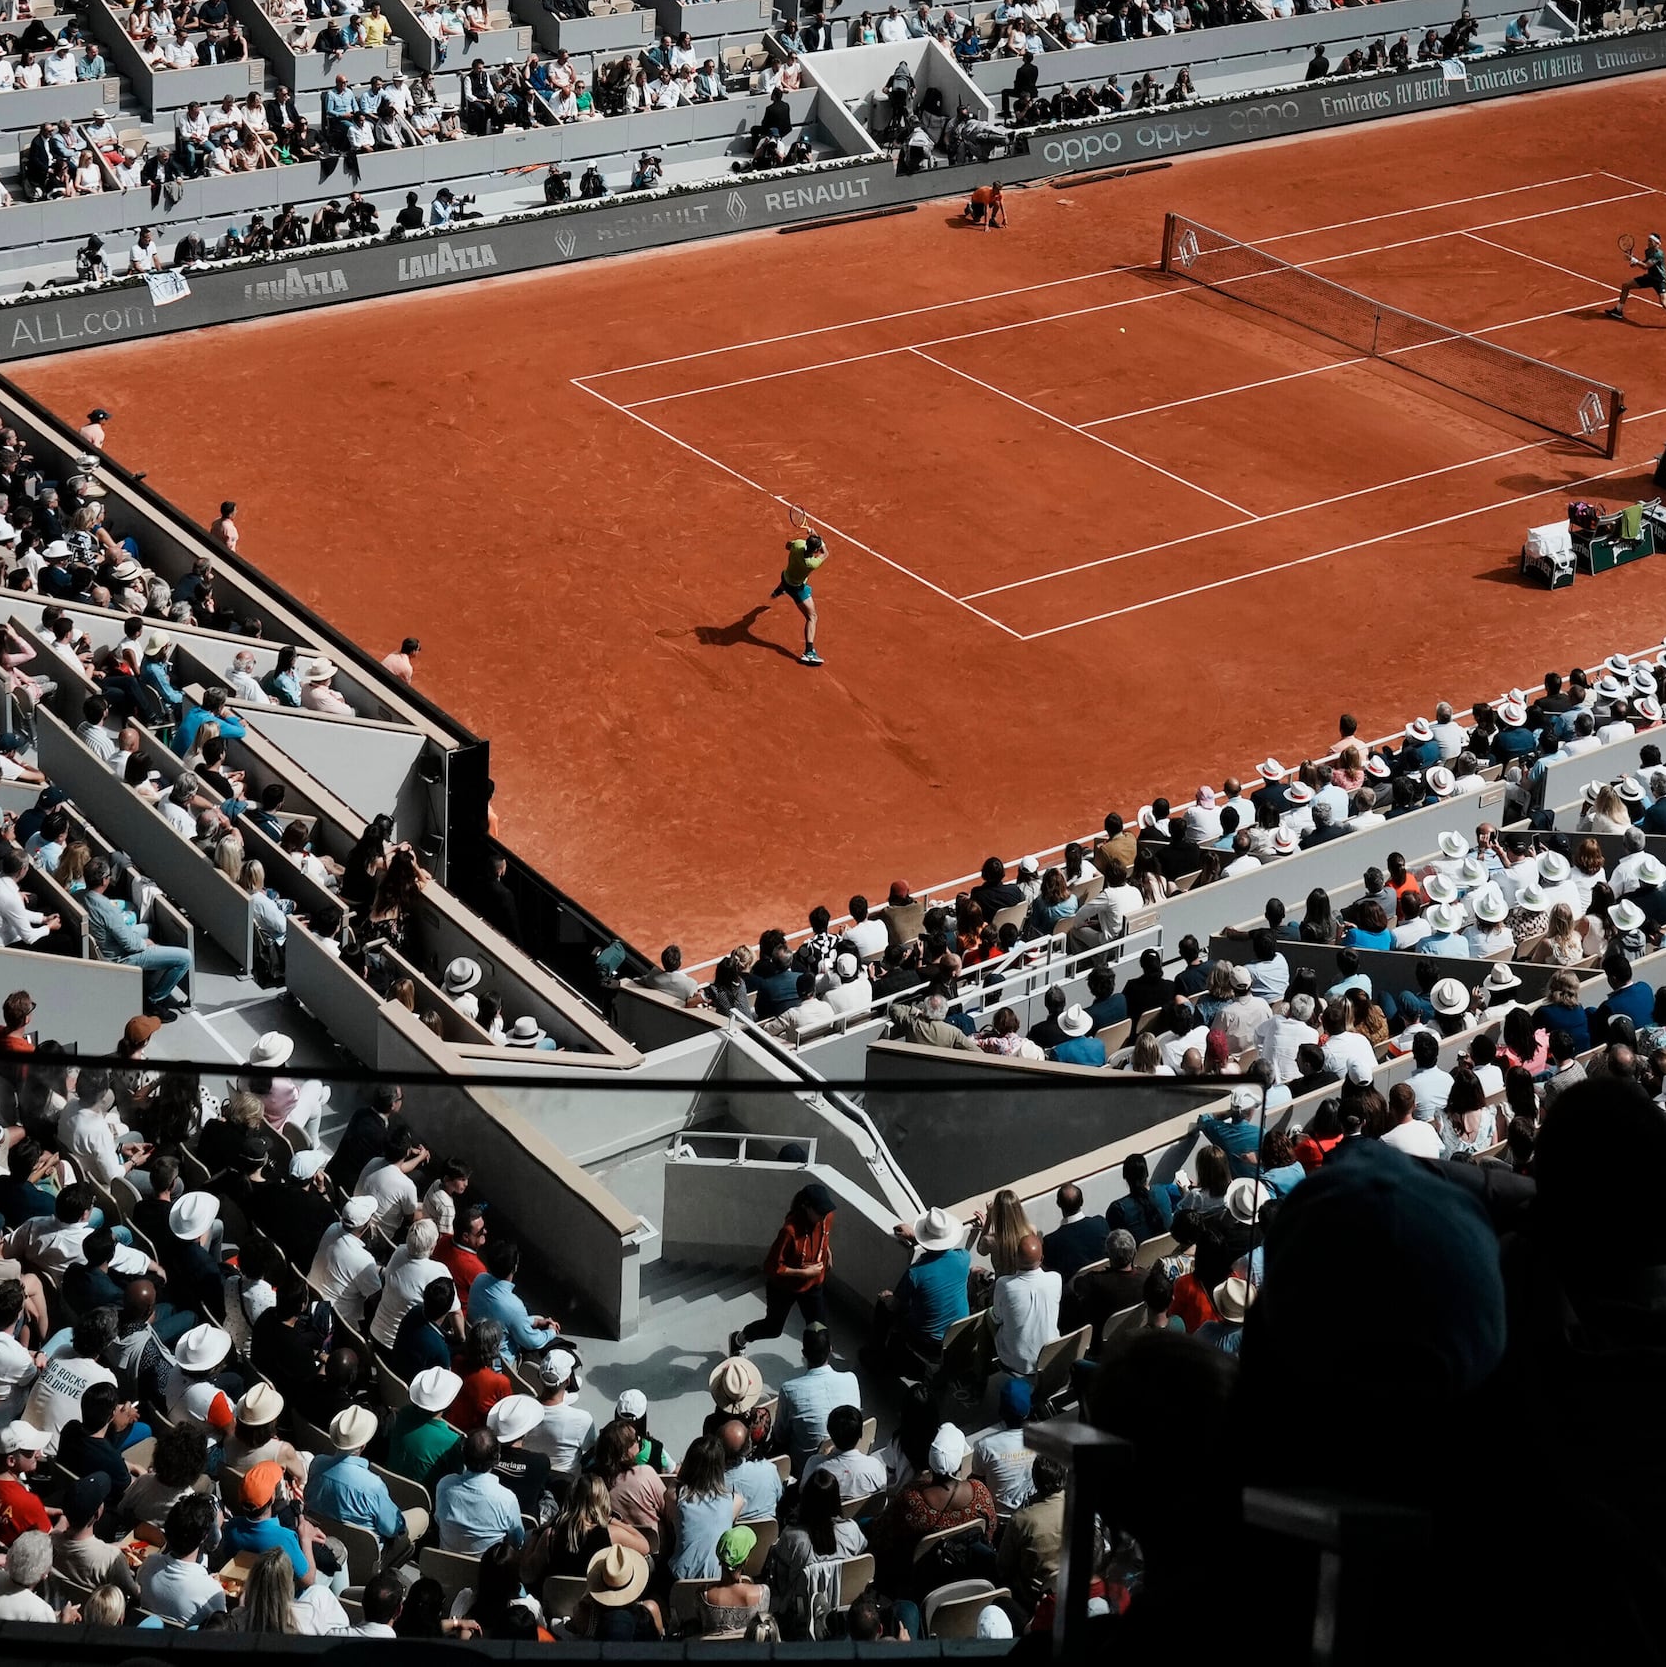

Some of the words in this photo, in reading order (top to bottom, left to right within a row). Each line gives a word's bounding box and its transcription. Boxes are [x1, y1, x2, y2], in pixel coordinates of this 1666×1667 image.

[1464, 67, 1528, 94] Emirates
[1532, 60, 1549, 81] FLY
[1550, 54, 1583, 78] BETTER
[1320, 89, 1392, 118] Emirates
[1396, 84, 1413, 105] FLY
[1414, 78, 1451, 102] BETTER
[1043, 132, 1122, 166] oppo
[765, 177, 871, 213] RENAULT
[244, 267, 350, 302] LAVAZZA
[398, 242, 498, 282] LAVAZZA
[11, 305, 158, 348] ALL.com
[51, 1379, 82, 1399] DRIVE
[57, 1368, 87, 1389] ROCKS
